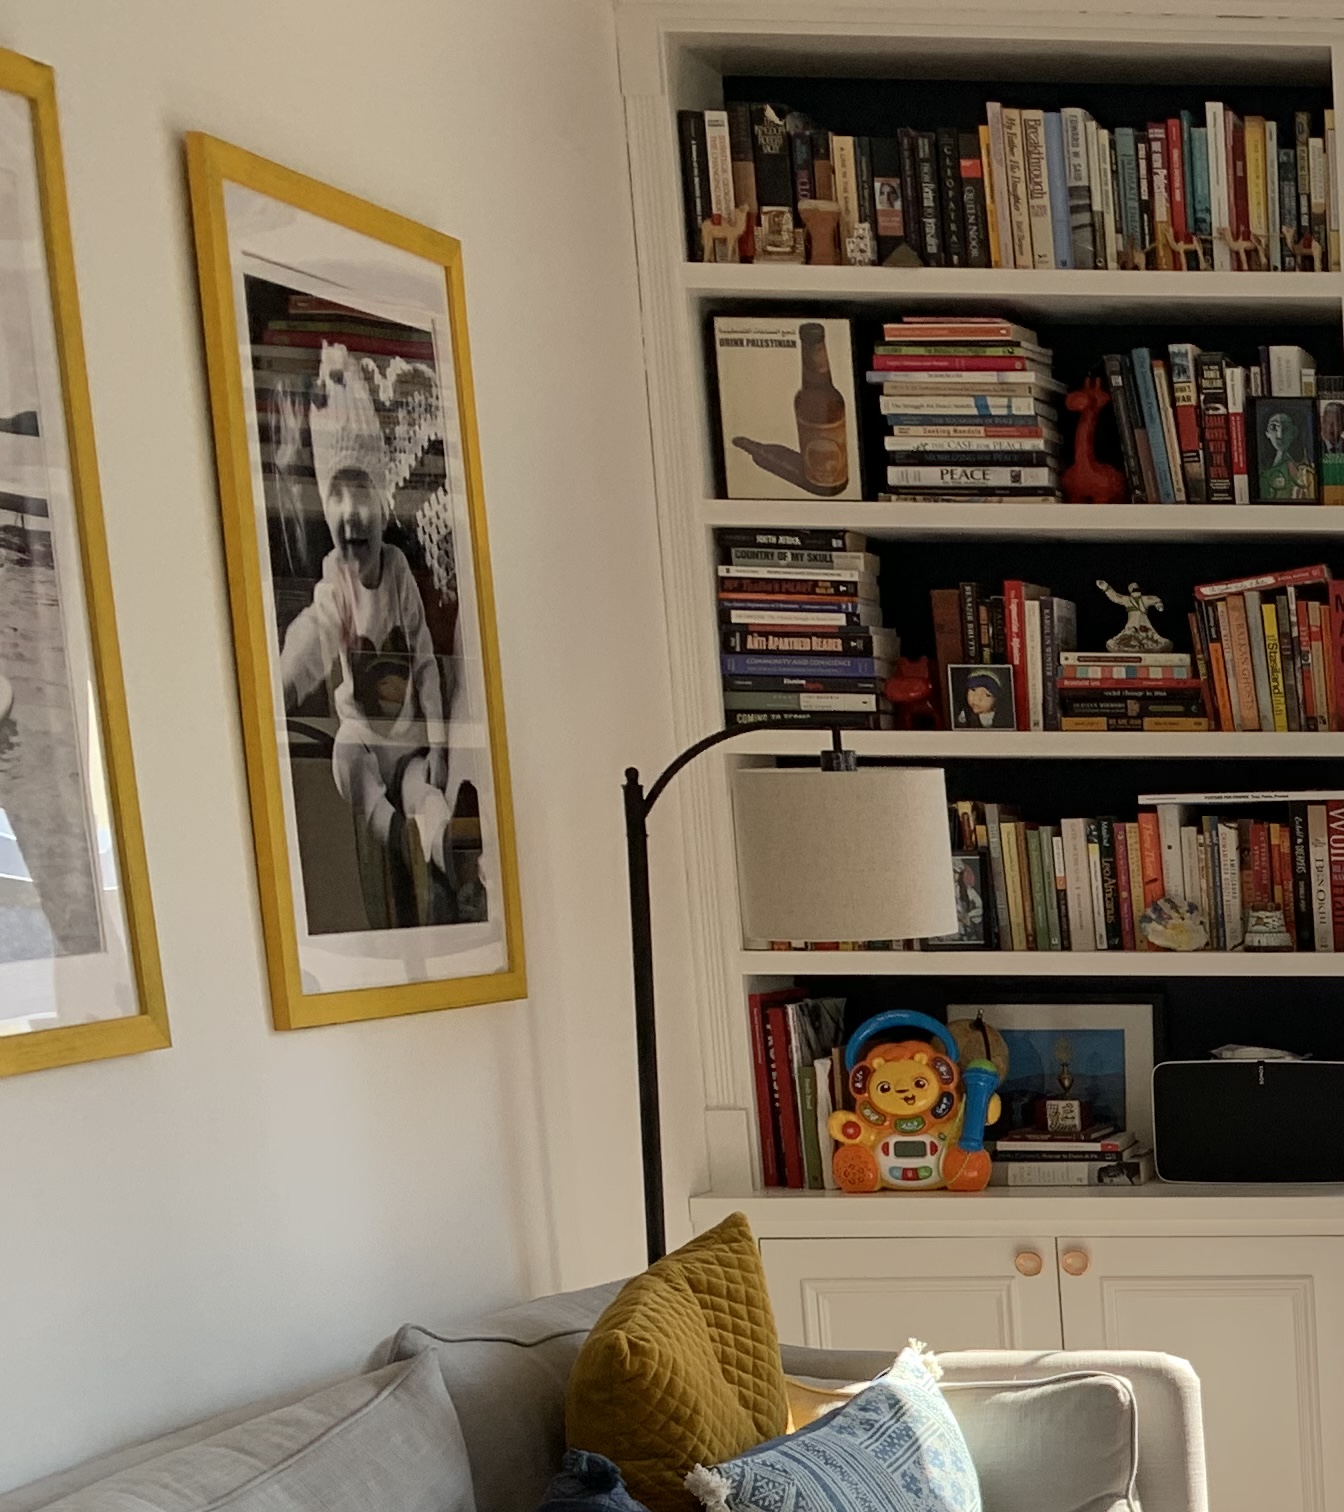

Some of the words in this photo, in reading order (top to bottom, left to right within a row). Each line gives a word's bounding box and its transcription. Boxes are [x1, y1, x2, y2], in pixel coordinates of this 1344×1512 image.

[1025, 119, 1046, 200] Breakthrough
[1073, 164, 1082, 182] SAID
[963, 186, 976, 224] QUEEN
[968, 225, 979, 258] NOOR
[746, 339, 797, 349] PALESTINIAN
[947, 441, 973, 449] CASE
[993, 442, 1023, 450] PEACE
[940, 468, 991, 481] PEACE
[735, 549, 775, 560] COUNTRY
[777, 551, 789, 561] OF
[791, 552, 804, 562] MY
[806, 552, 834, 563] SKULL
[1268, 643, 1282, 695] Stasiland
[1102, 858, 1112, 876] Leo
[1103, 877, 1116, 923] Africanus
